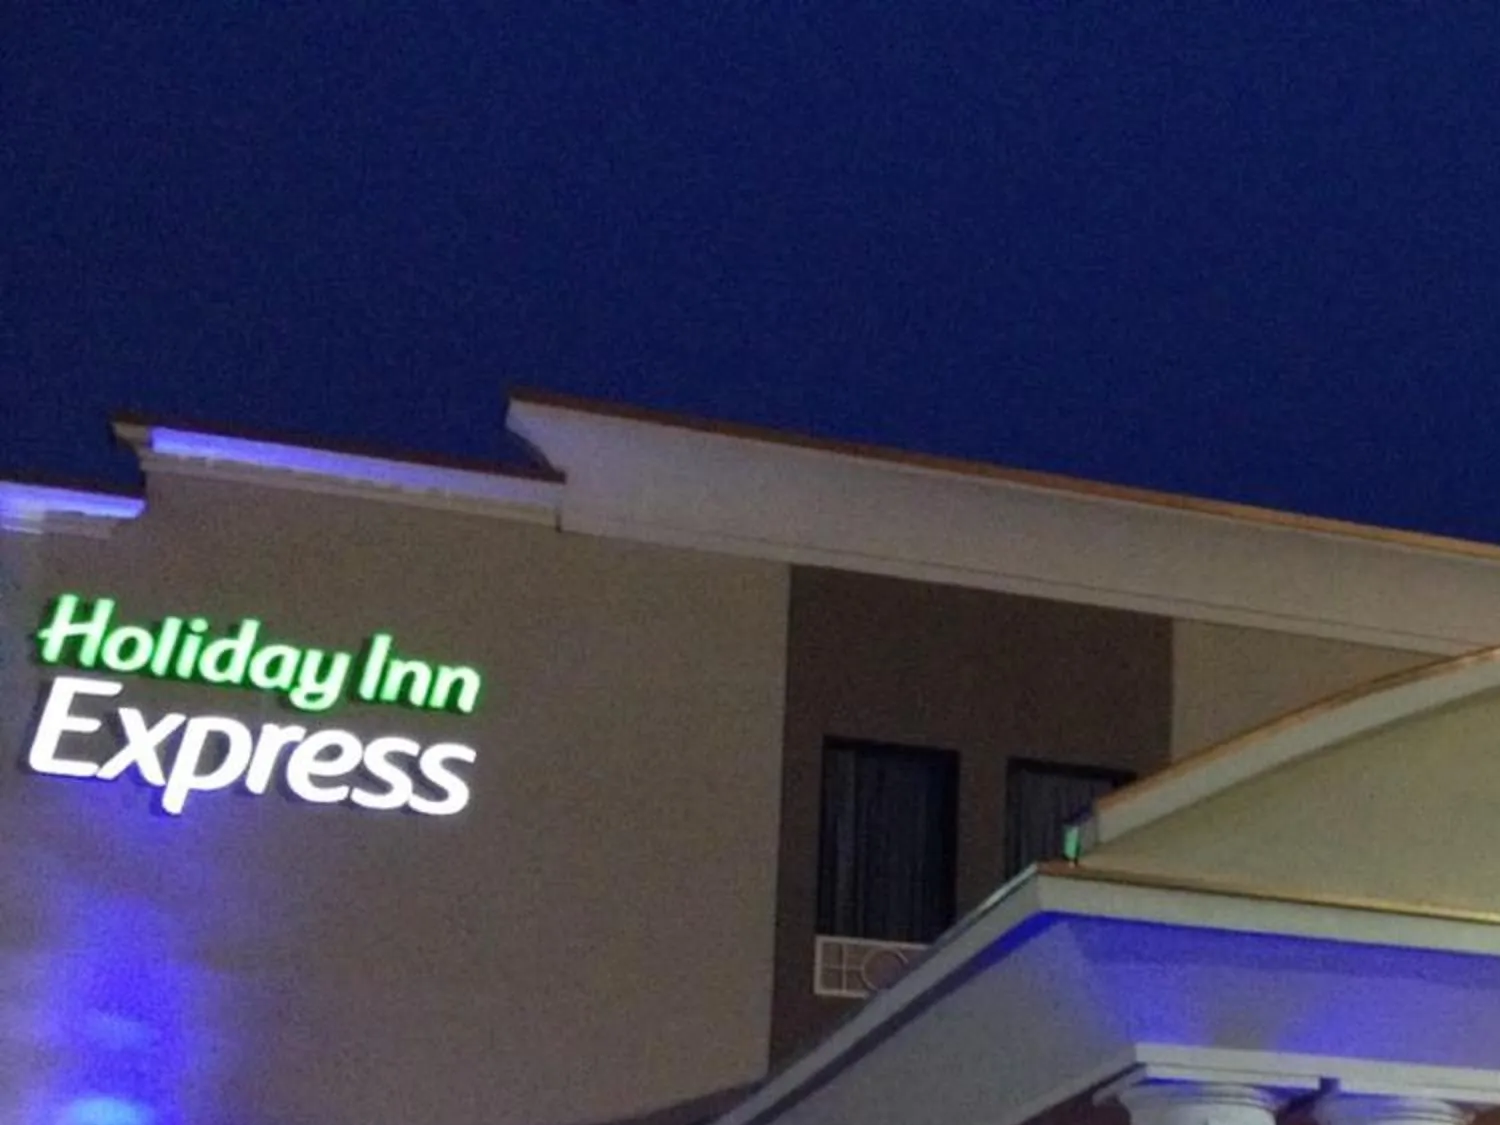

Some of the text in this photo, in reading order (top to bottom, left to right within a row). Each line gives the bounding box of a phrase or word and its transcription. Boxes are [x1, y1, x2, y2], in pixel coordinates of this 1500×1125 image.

[38, 594, 482, 714] Holiday Inn
[27, 676, 478, 816] Express
